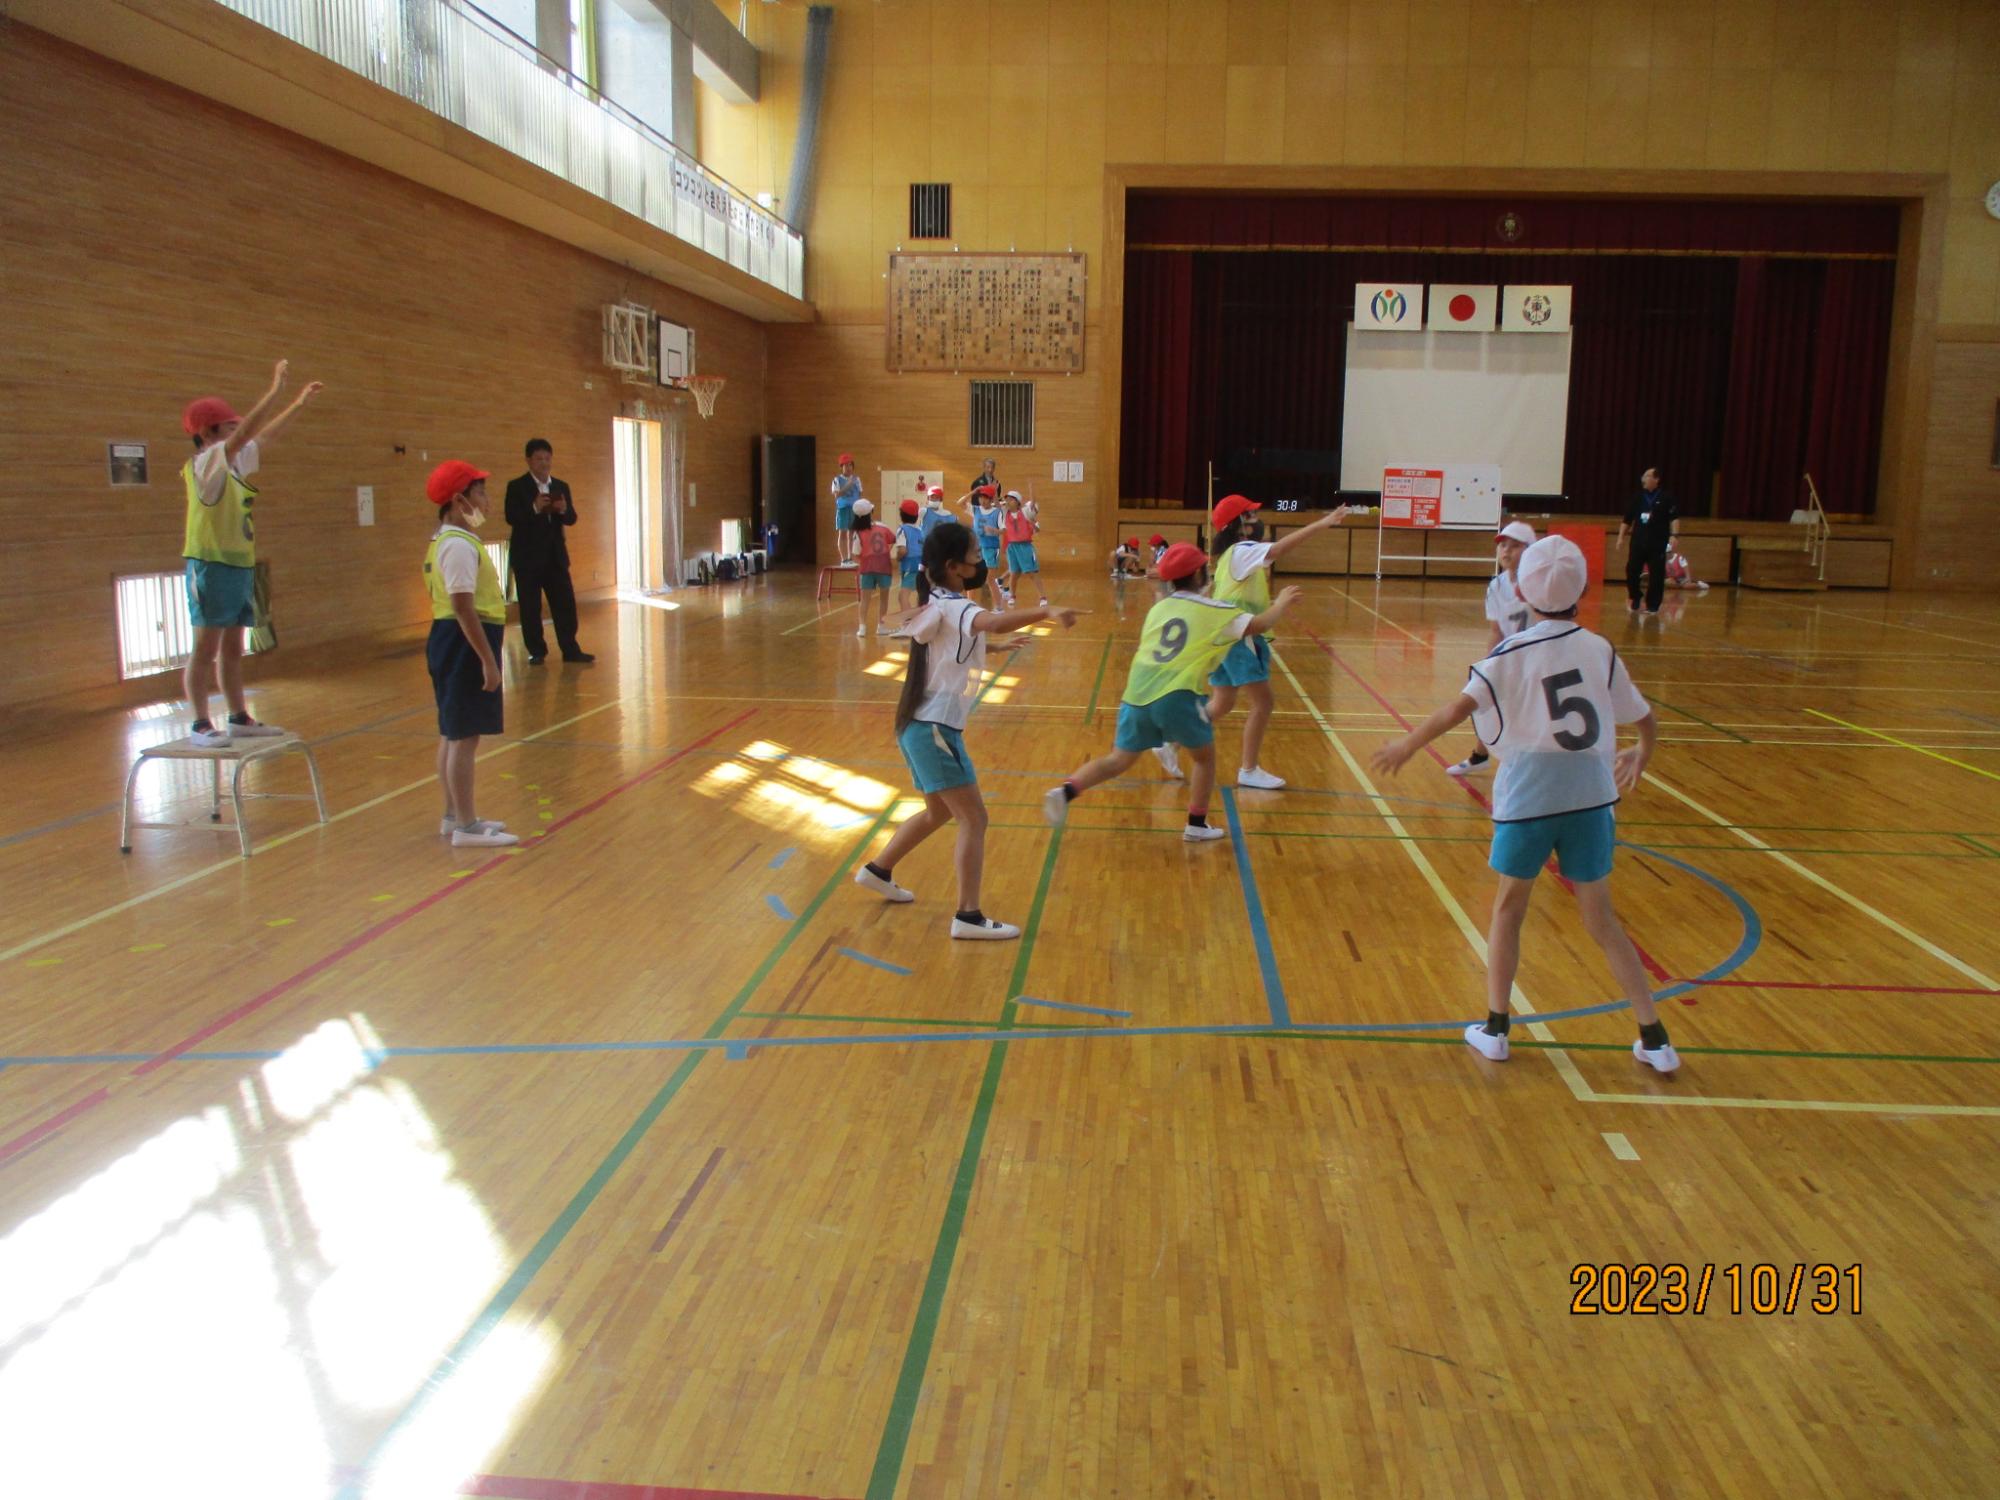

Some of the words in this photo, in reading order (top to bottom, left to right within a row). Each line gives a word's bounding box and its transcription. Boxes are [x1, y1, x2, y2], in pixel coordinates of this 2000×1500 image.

[1152, 617, 1189, 663] 9
[1508, 610, 1528, 632] 7
[1541, 668, 1601, 751] 5
